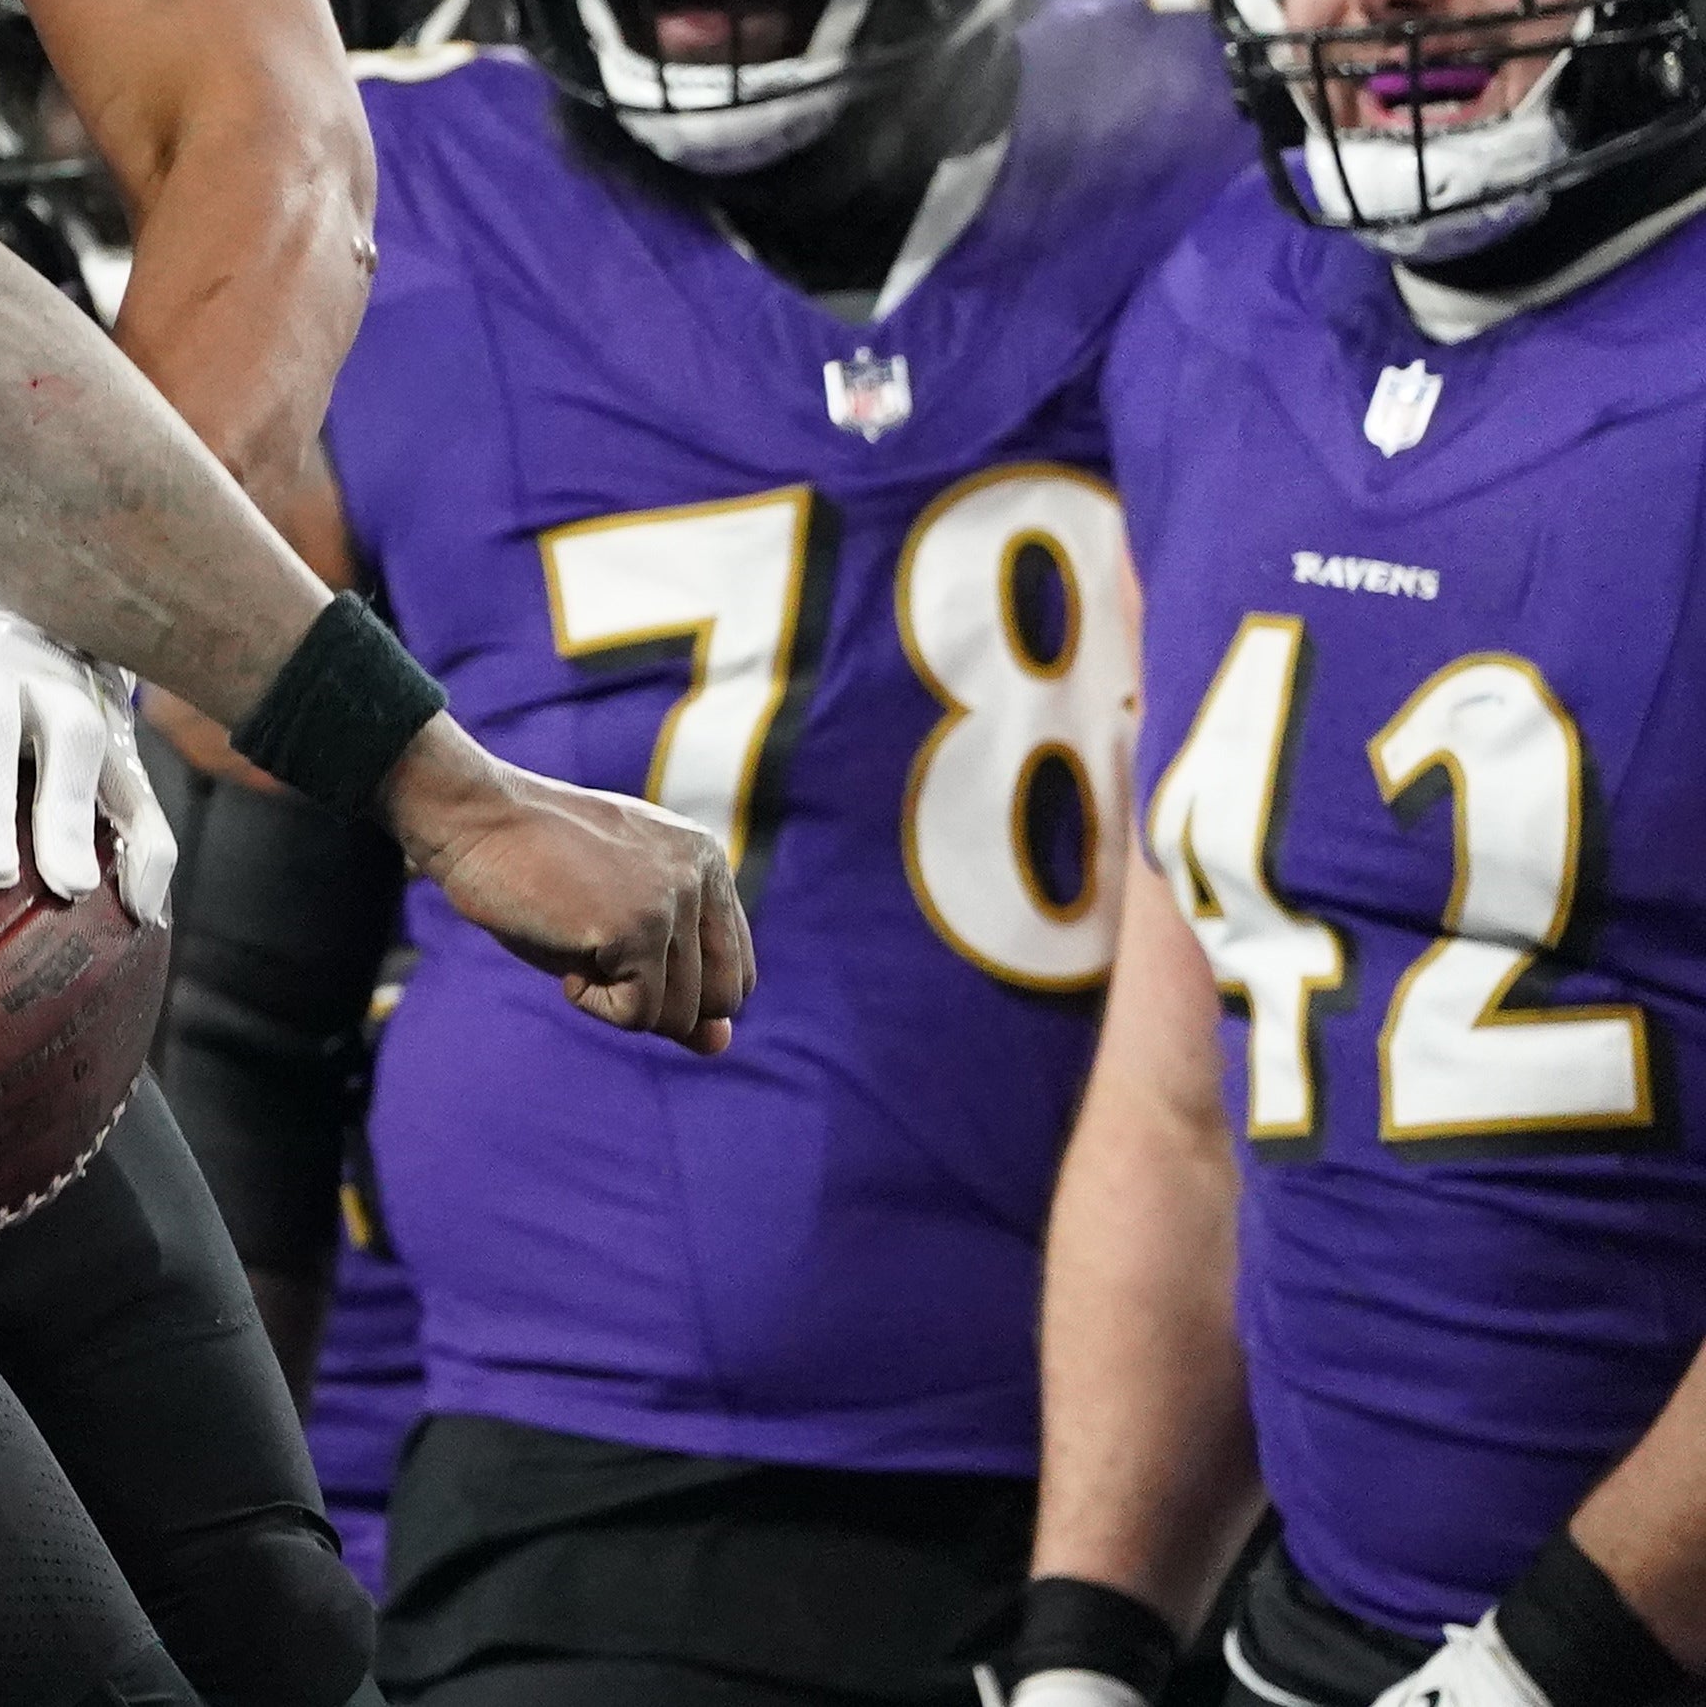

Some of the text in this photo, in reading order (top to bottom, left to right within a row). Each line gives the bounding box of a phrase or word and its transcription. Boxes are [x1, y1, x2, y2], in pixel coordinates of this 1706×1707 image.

[539, 462, 1142, 990] 78
[1290, 551, 1440, 601] RAVENS
[1145, 612, 1657, 1144] 42
